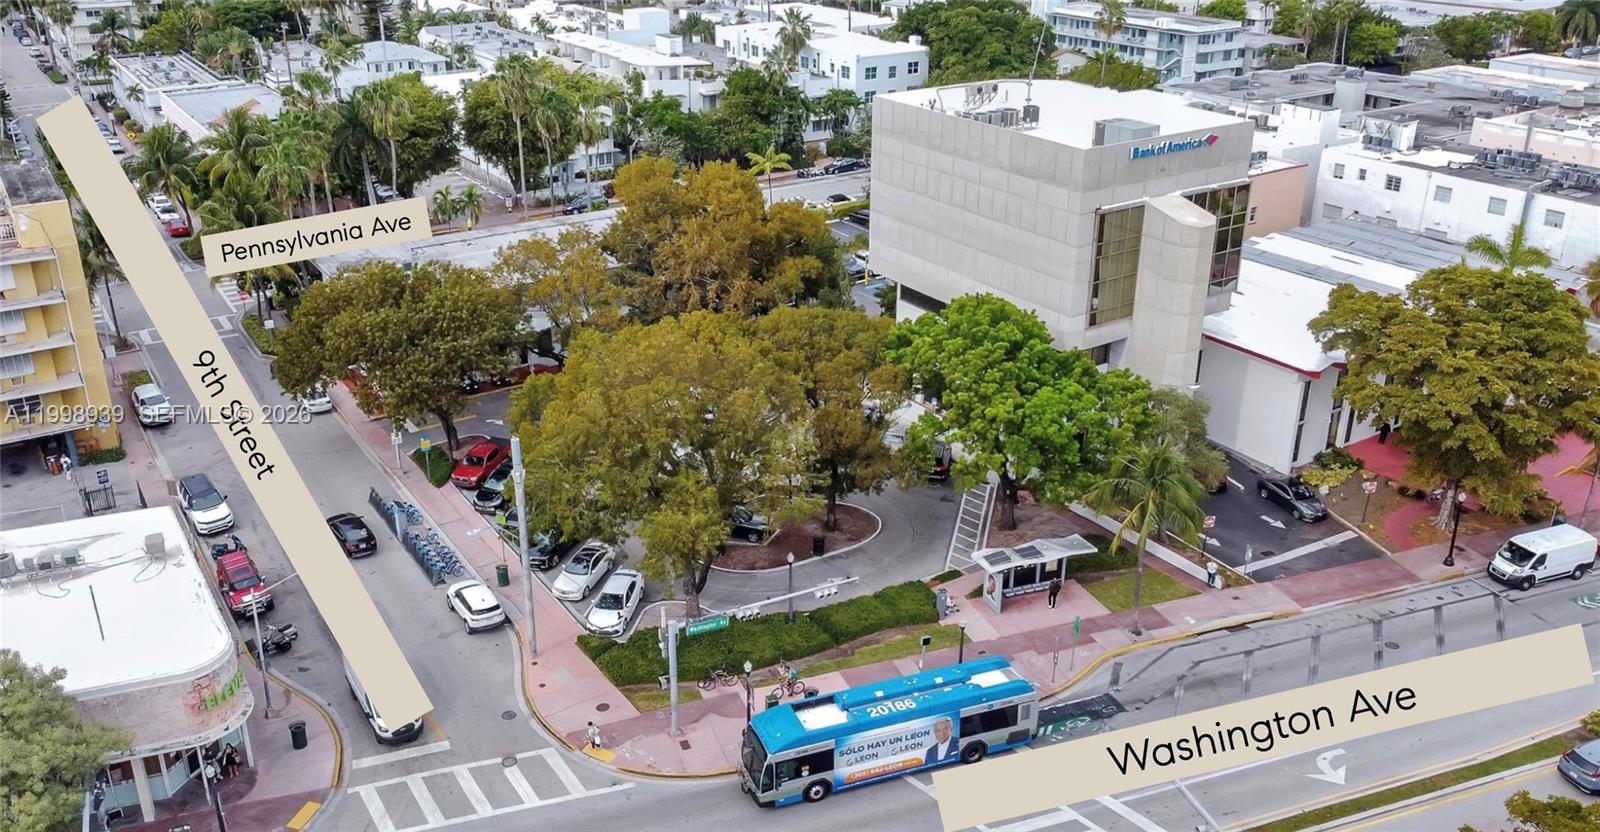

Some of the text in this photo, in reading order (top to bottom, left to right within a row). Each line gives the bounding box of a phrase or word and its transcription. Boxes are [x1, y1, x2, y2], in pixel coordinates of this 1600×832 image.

[1131, 138, 1202, 159] Bank of America
[689, 622, 717, 632] Washington
[866, 698, 916, 718] 20186
[867, 739, 888, 751] HAY
[889, 736, 903, 745] UN
[905, 729, 931, 741] LEON
[900, 741, 923, 752] LEON
[855, 752, 879, 763] LEON
